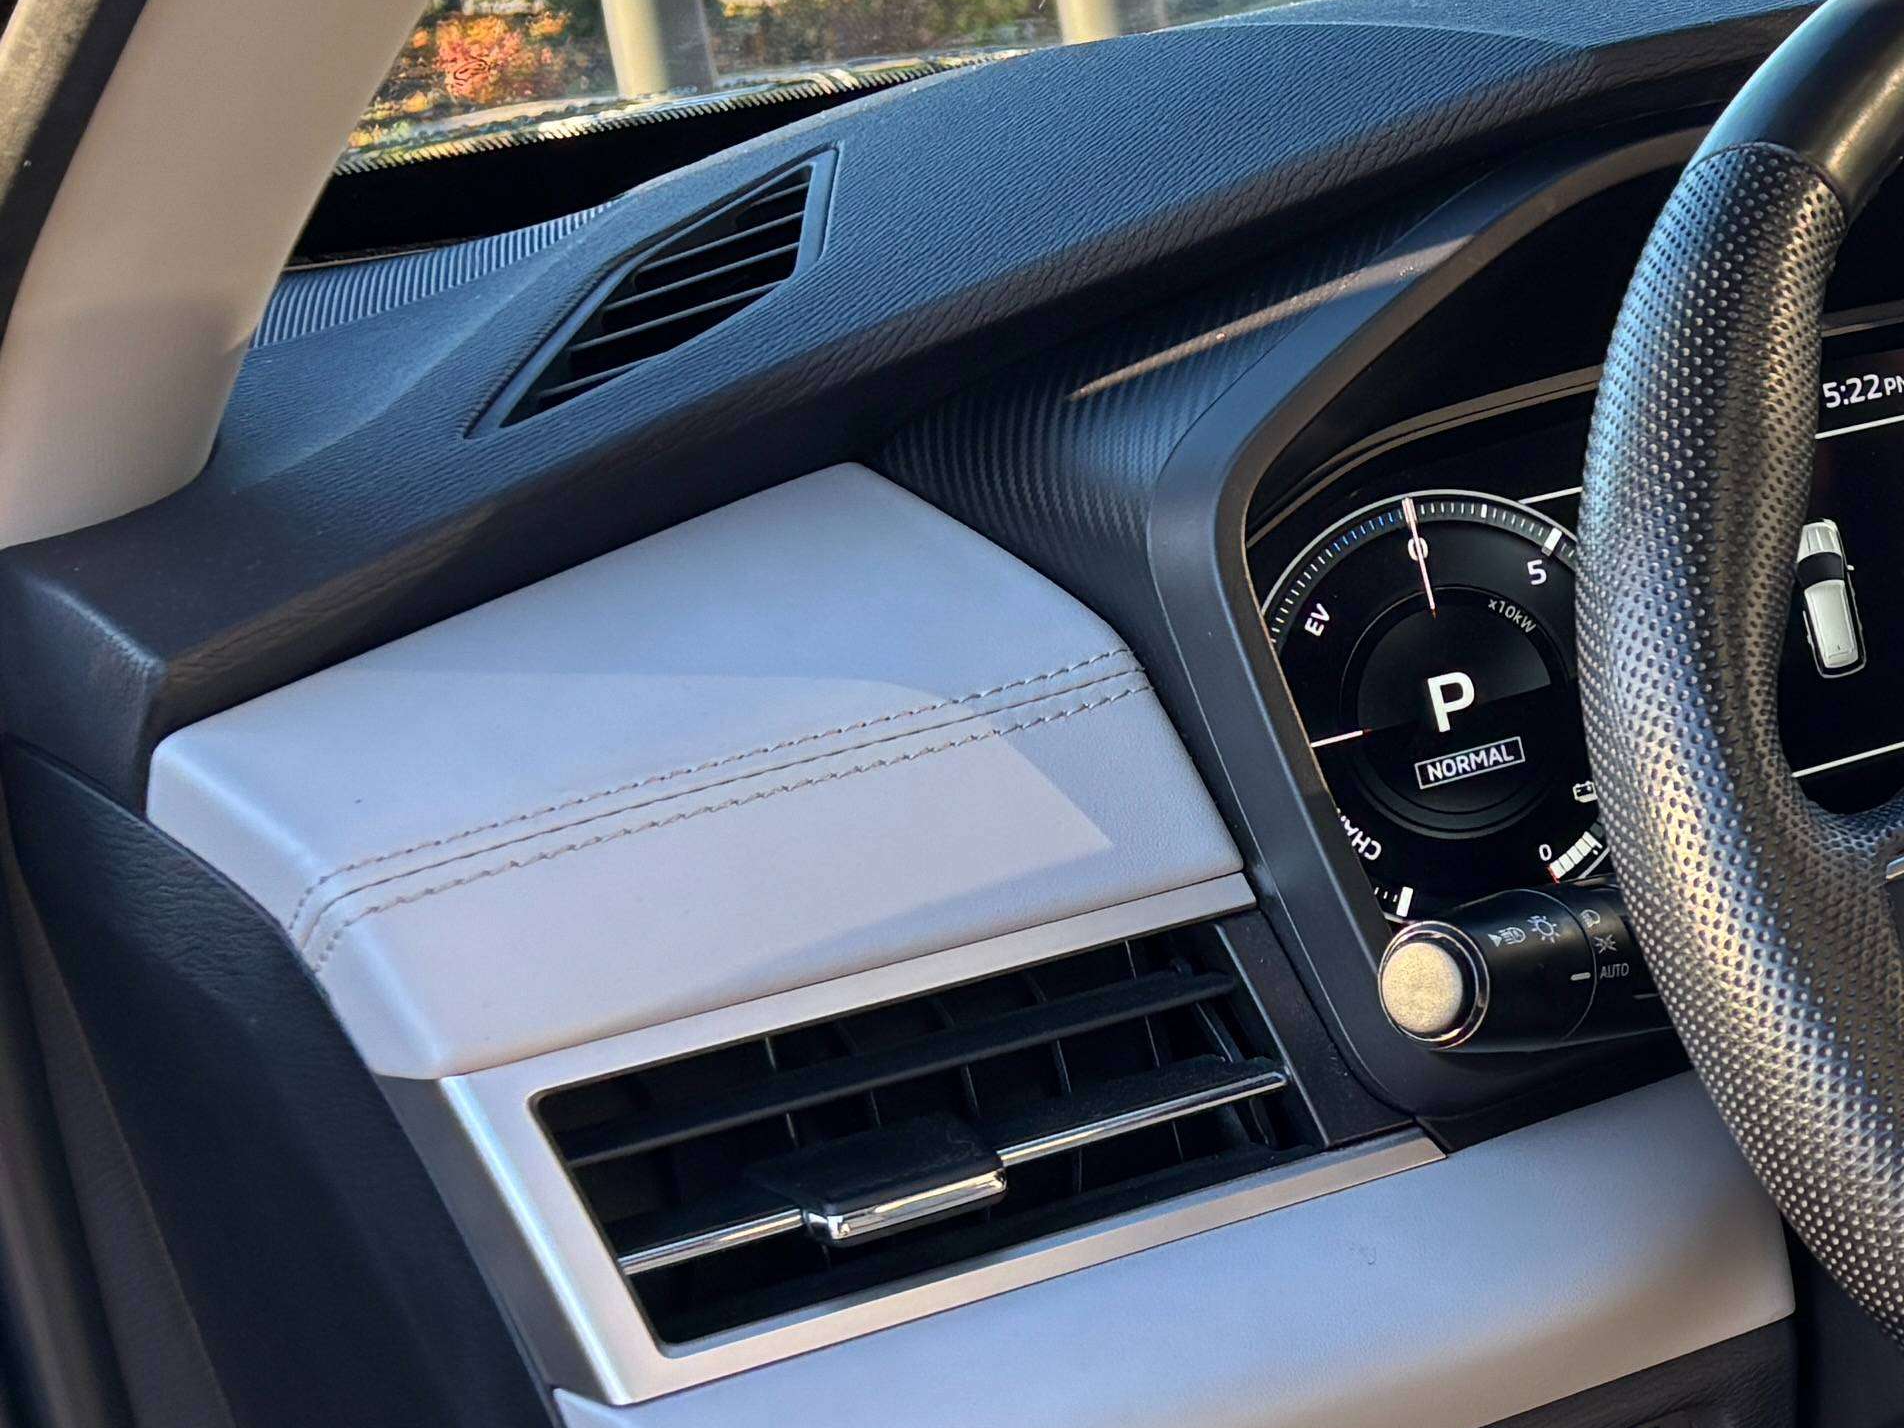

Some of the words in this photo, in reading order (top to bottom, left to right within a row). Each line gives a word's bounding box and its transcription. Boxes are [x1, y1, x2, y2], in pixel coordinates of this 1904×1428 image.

[1407, 536, 1429, 562] 0
[1526, 558, 1548, 586] 5
[1303, 602, 1332, 638] EV
[1487, 597, 1538, 635] x10kW
[1426, 671, 1475, 733] P
[1426, 742, 1515, 783] NORMAL
[1538, 843, 1553, 862] 0
[1600, 962, 1630, 980] AUTO
